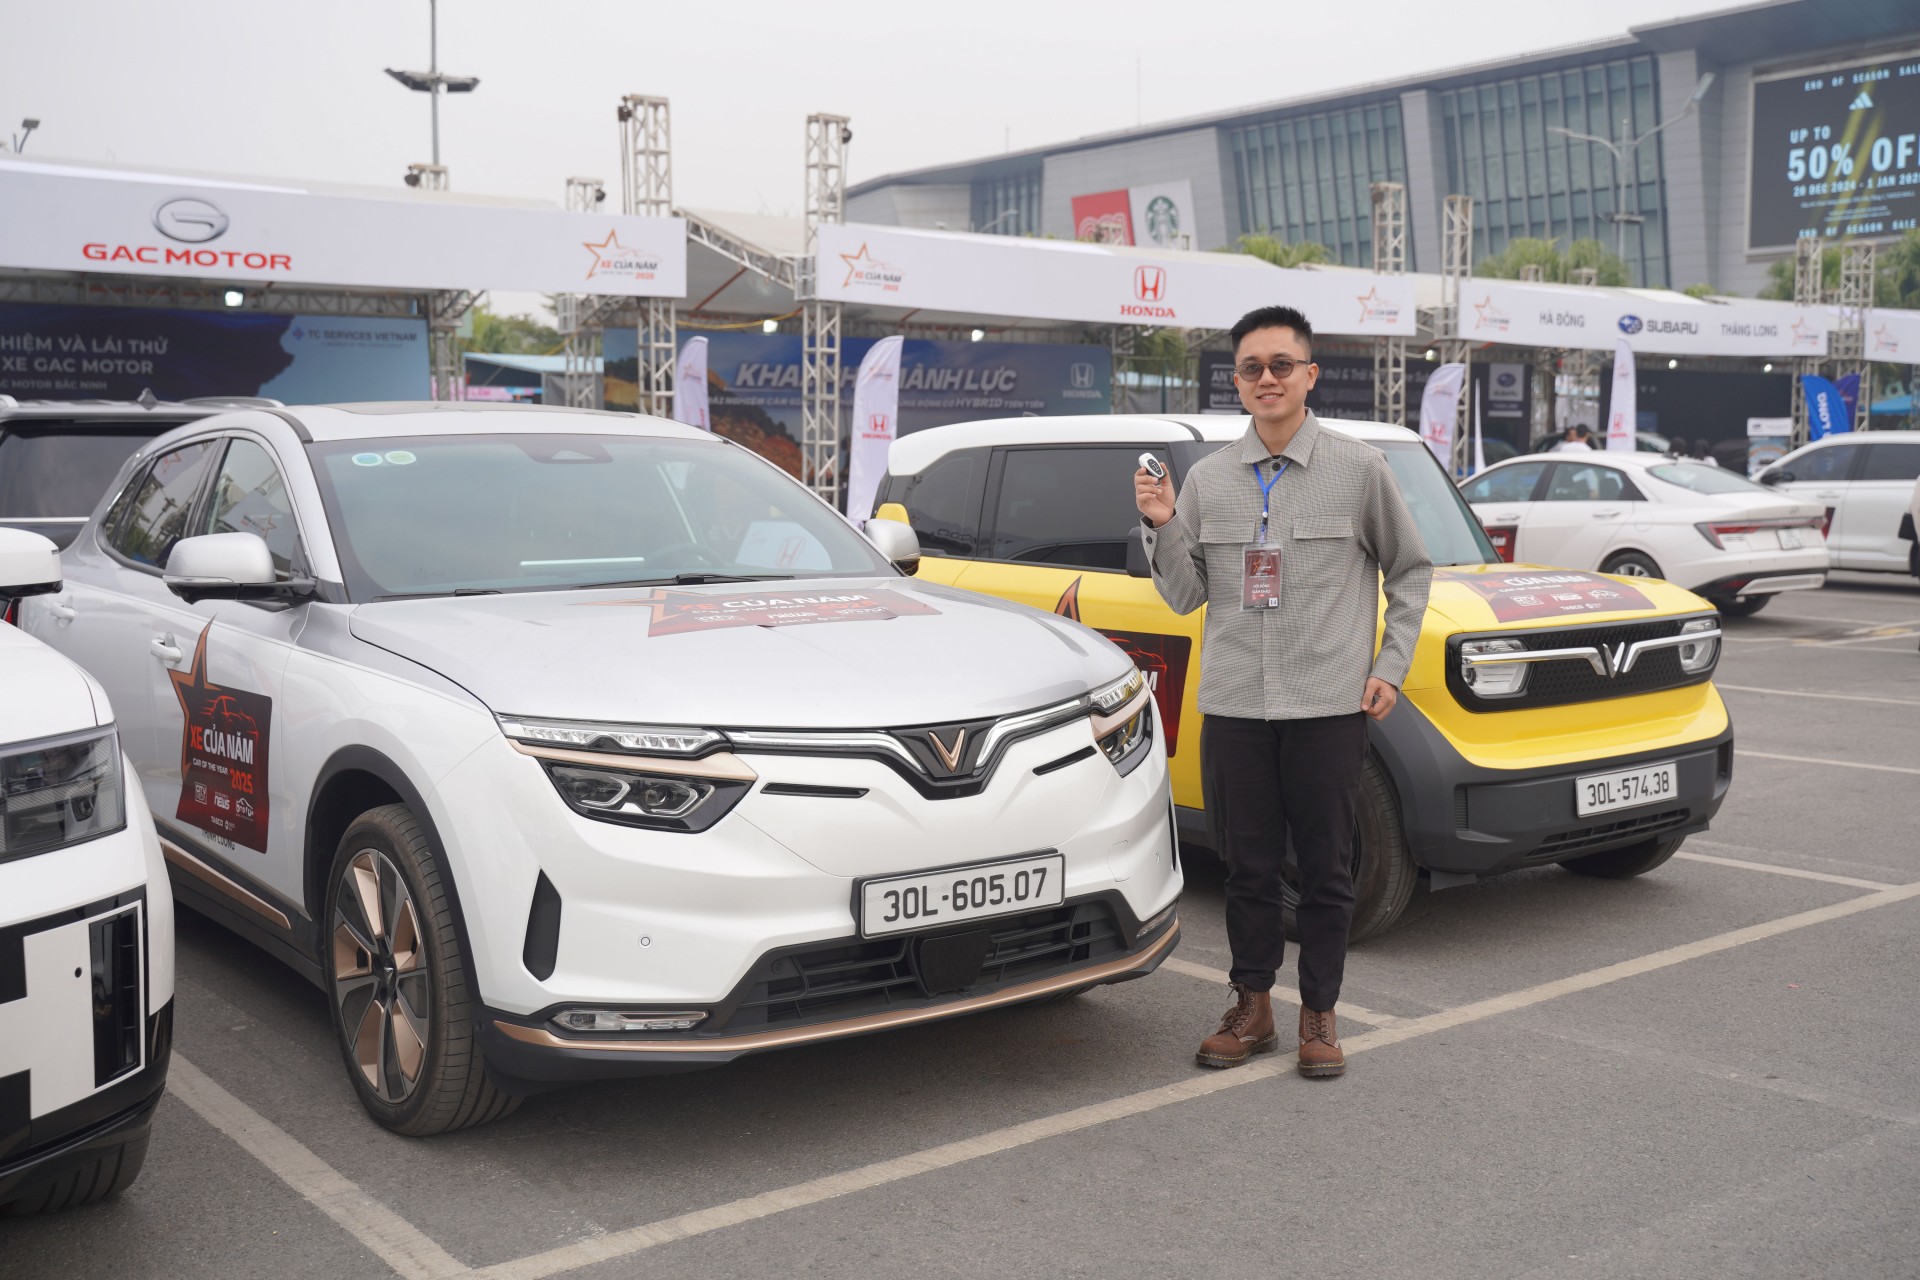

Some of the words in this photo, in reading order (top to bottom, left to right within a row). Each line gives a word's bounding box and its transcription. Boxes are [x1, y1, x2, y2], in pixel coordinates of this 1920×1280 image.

[1804, 79, 1823, 91] END
[1832, 76, 1844, 87] OF
[1852, 69, 1890, 84] SEASON
[1789, 129, 1808, 144] UP
[1813, 125, 1831, 141] TO
[1787, 142, 1854, 182] 50%
[1871, 133, 1920, 172] OF
[1877, 175, 1896, 188] JAN
[1846, 222, 1883, 234] SEASON
[1892, 218, 1916, 230] SALE
[82, 243, 158, 264] GAC
[164, 248, 292, 271] MOTOR
[1120, 304, 1176, 318] HONDA
[323, 329, 373, 341] SERVICES
[375, 331, 417, 342] VIETNAM
[1646, 320, 1698, 335] SUBARU
[1753, 325, 1778, 337] LONG
[0, 332, 52, 354] HIỆM
[58, 334, 86, 351] VÀ
[92, 335, 122, 353] LÁI
[128, 335, 168, 355] THỬ
[2, 356, 27, 372] XE
[34, 357, 76, 373] GAC
[82, 359, 153, 374] MOTOR
[964, 366, 1017, 395] LỰC
[956, 397, 1002, 408] HYBRID
[1063, 390, 1102, 398] HONDA
[190, 724, 203, 751] XE
[203, 724, 226, 758] CỦA
[227, 731, 254, 765] NĂM
[193, 757, 202, 767] CAR
[230, 768, 254, 794] 2025
[1587, 771, 1669, 807] 30L-574.38
[883, 867, 1047, 923] 30L-605.07
